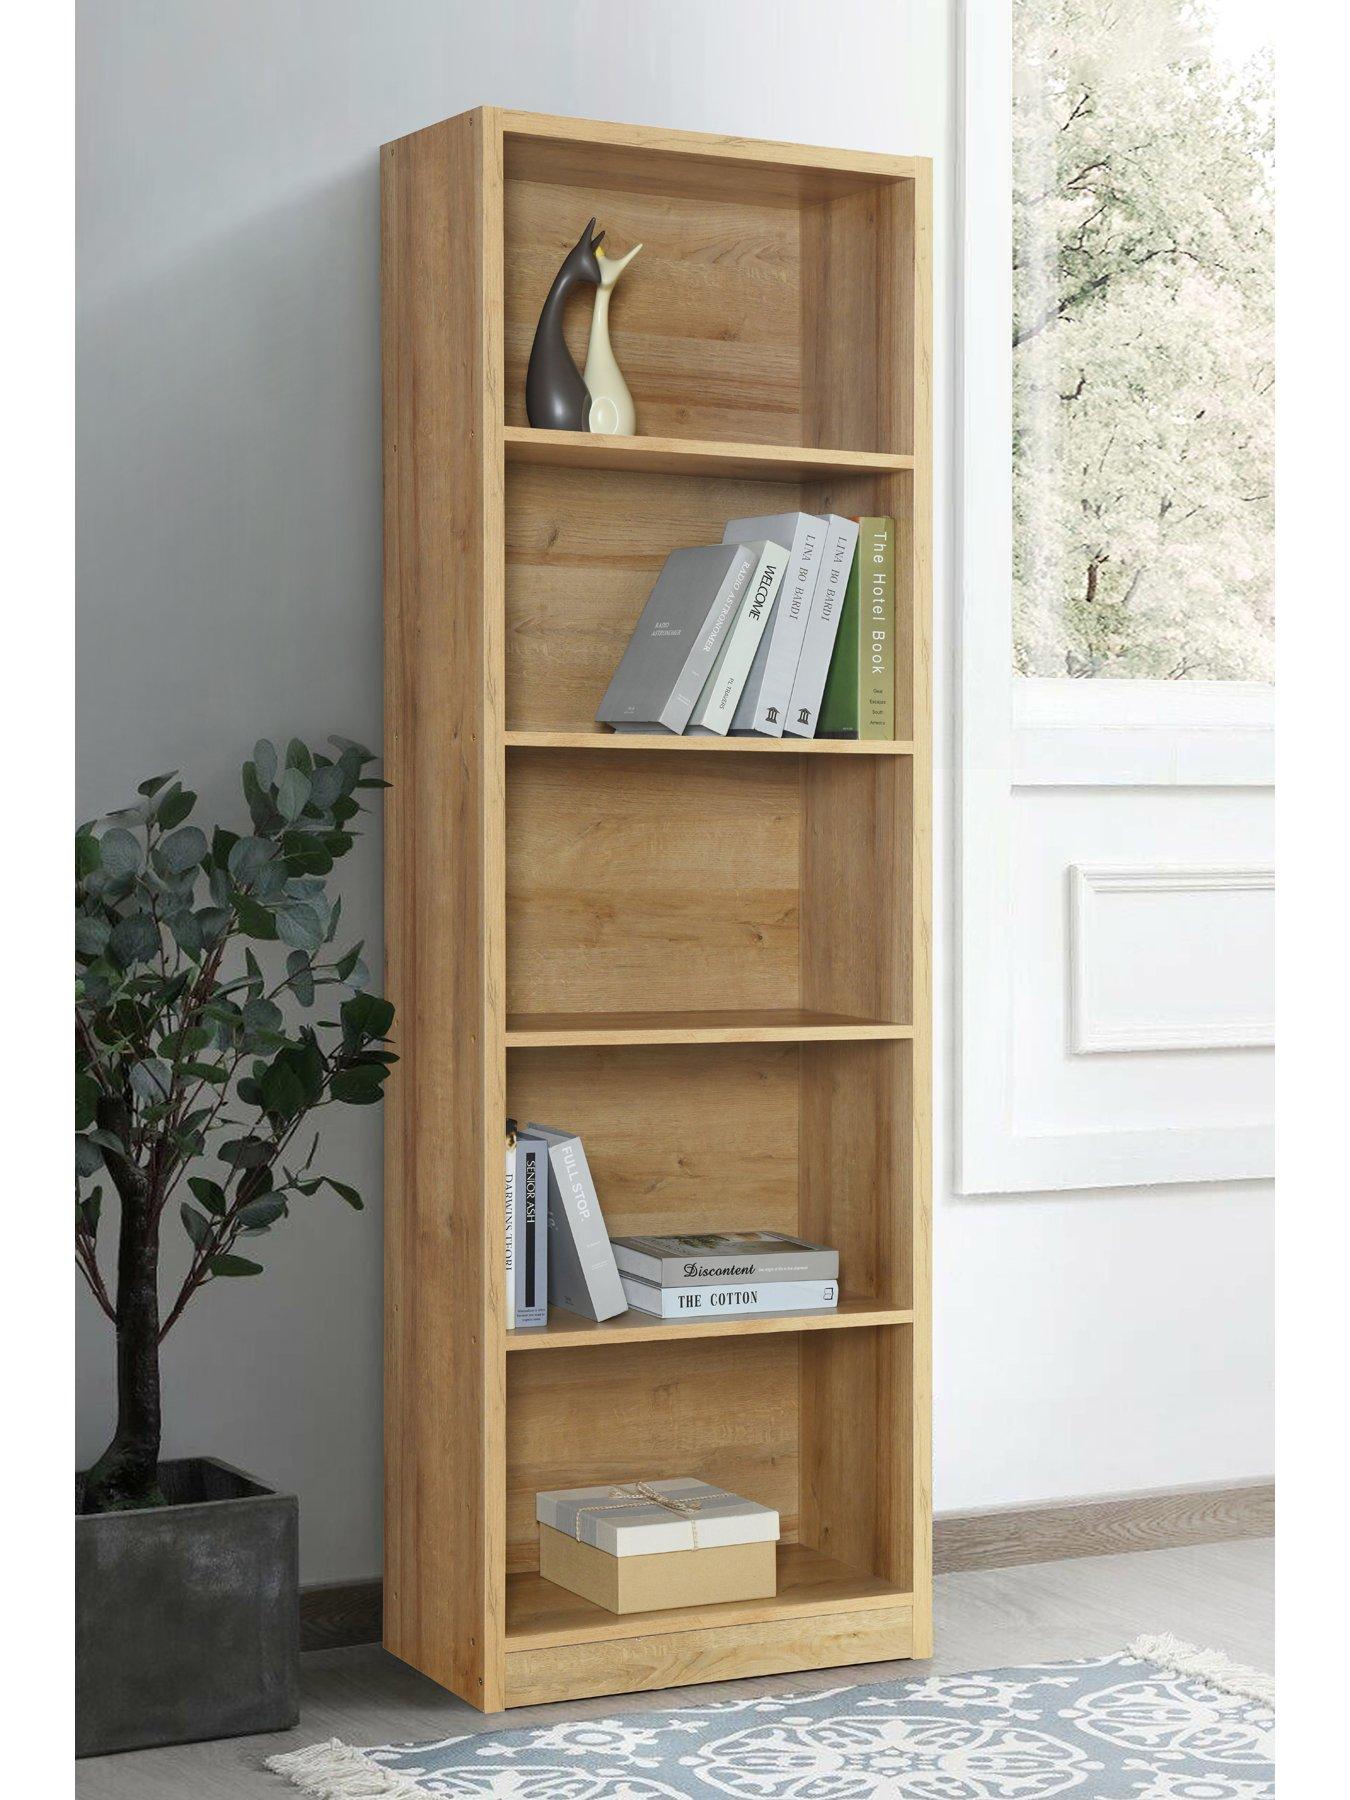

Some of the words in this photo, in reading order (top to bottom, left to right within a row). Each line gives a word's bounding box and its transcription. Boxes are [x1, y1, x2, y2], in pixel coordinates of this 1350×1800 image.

[801, 534, 816, 562] LINA
[833, 536, 848, 564] LINA
[873, 532, 887, 563] The
[733, 561, 751, 590] RADIO
[797, 567, 809, 585] BO
[828, 568, 841, 584] BO
[748, 565, 777, 621] WELCOME
[789, 586, 805, 620] BARDI
[821, 588, 836, 622] BARDI
[872, 573, 886, 621] Hotel
[872, 631, 886, 674] Book
[561, 1146, 579, 1181] FULL
[526, 1160, 536, 1199] SENIOR
[526, 1201, 536, 1223] ASH
[683, 1263, 756, 1278] Discontent
[678, 1294, 702, 1308] THE
[710, 1290, 758, 1306] COTTON
